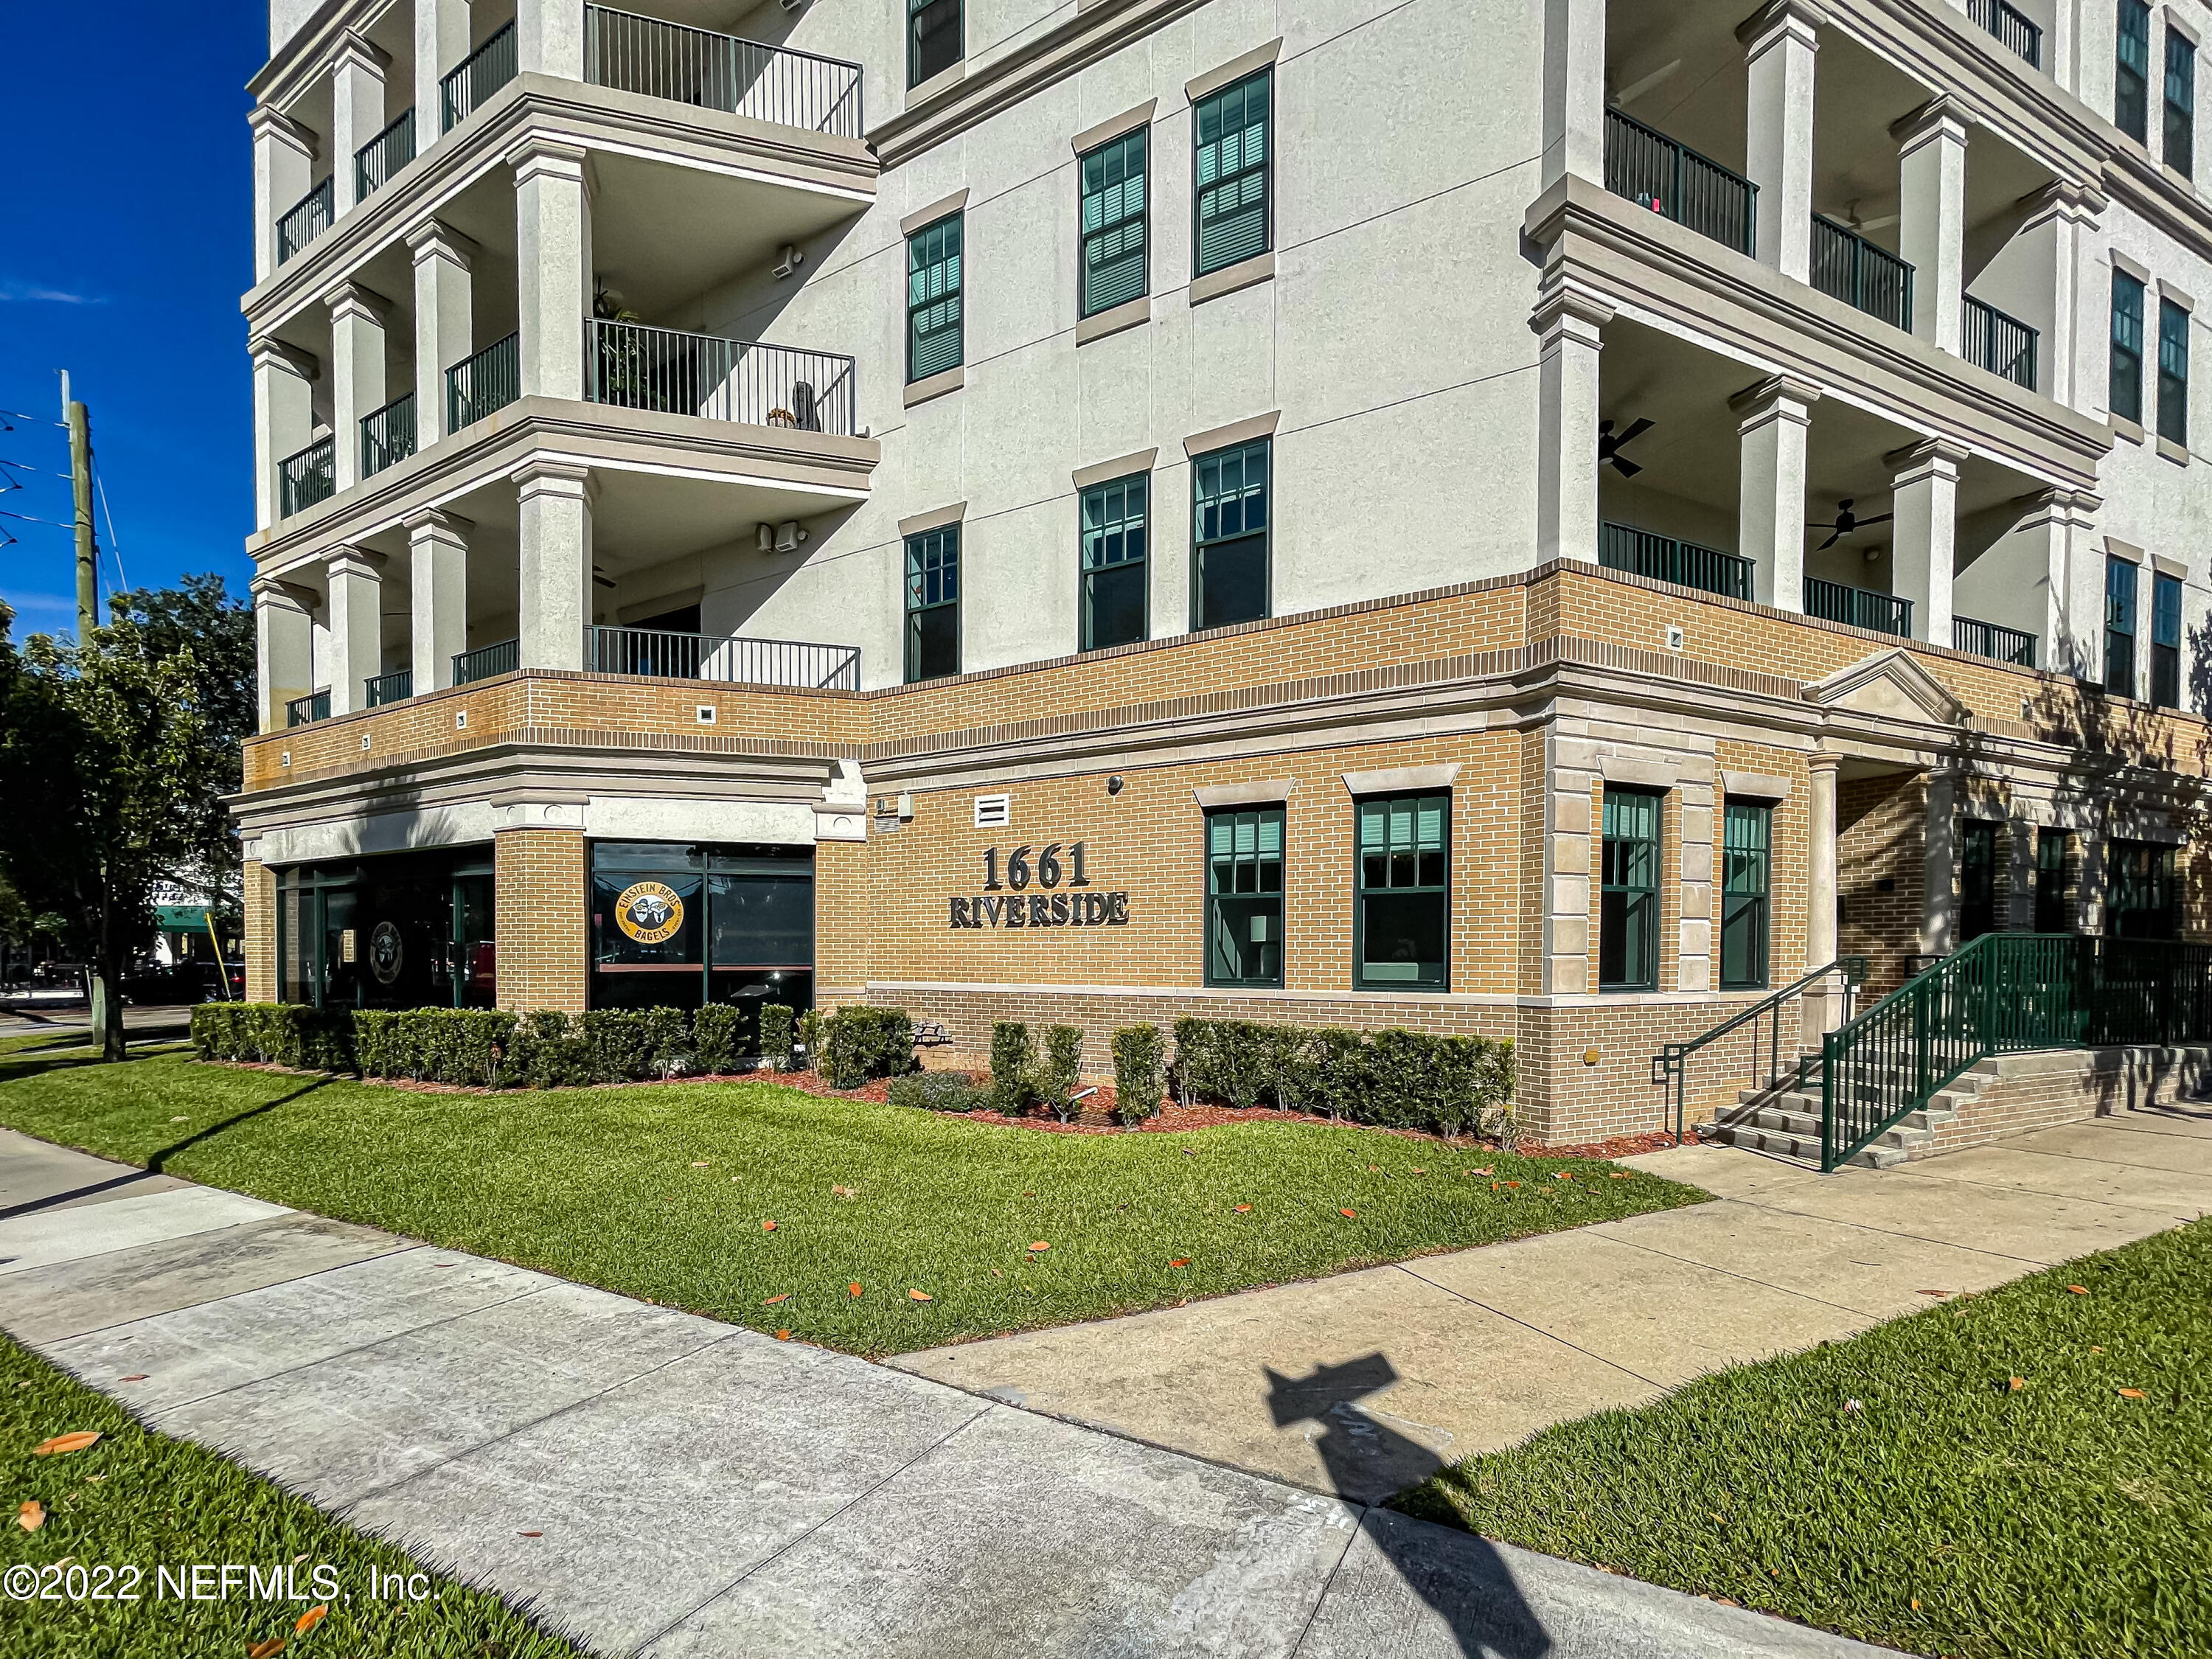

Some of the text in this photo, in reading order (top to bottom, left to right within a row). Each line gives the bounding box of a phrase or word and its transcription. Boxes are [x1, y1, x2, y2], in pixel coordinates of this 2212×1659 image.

[983, 841, 1091, 891] 1661
[619, 883, 680, 908] EINSTEIN BROS
[949, 891, 1130, 929] RIVERSIDE
[635, 928, 669, 941] BAGELS
